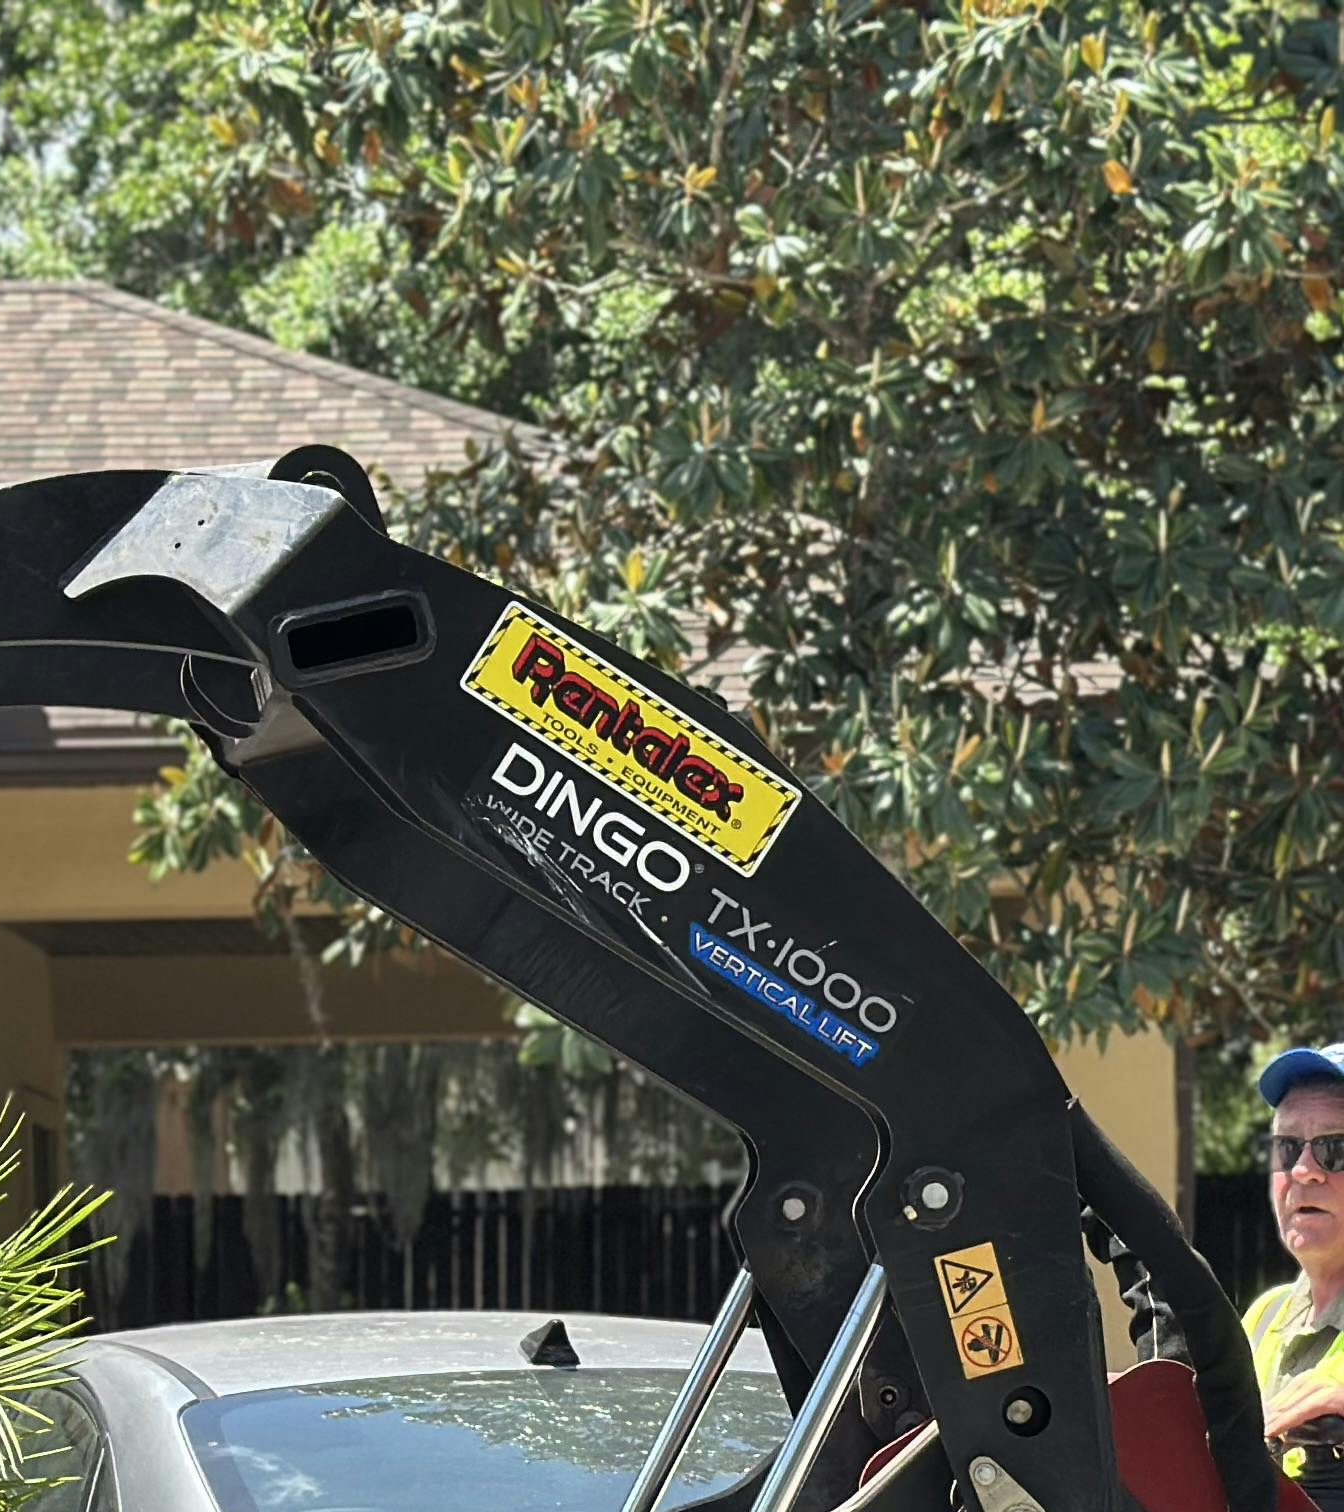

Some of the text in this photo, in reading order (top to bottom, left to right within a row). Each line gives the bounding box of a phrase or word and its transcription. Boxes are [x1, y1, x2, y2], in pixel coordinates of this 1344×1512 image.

[512, 632, 744, 823] Rentalex
[543, 713, 721, 836] TOOLS EQUIPMENT
[492, 742, 690, 892] DINGO
[558, 841, 651, 915] TRACK
[695, 932, 873, 1058] VERTICAL LIFT
